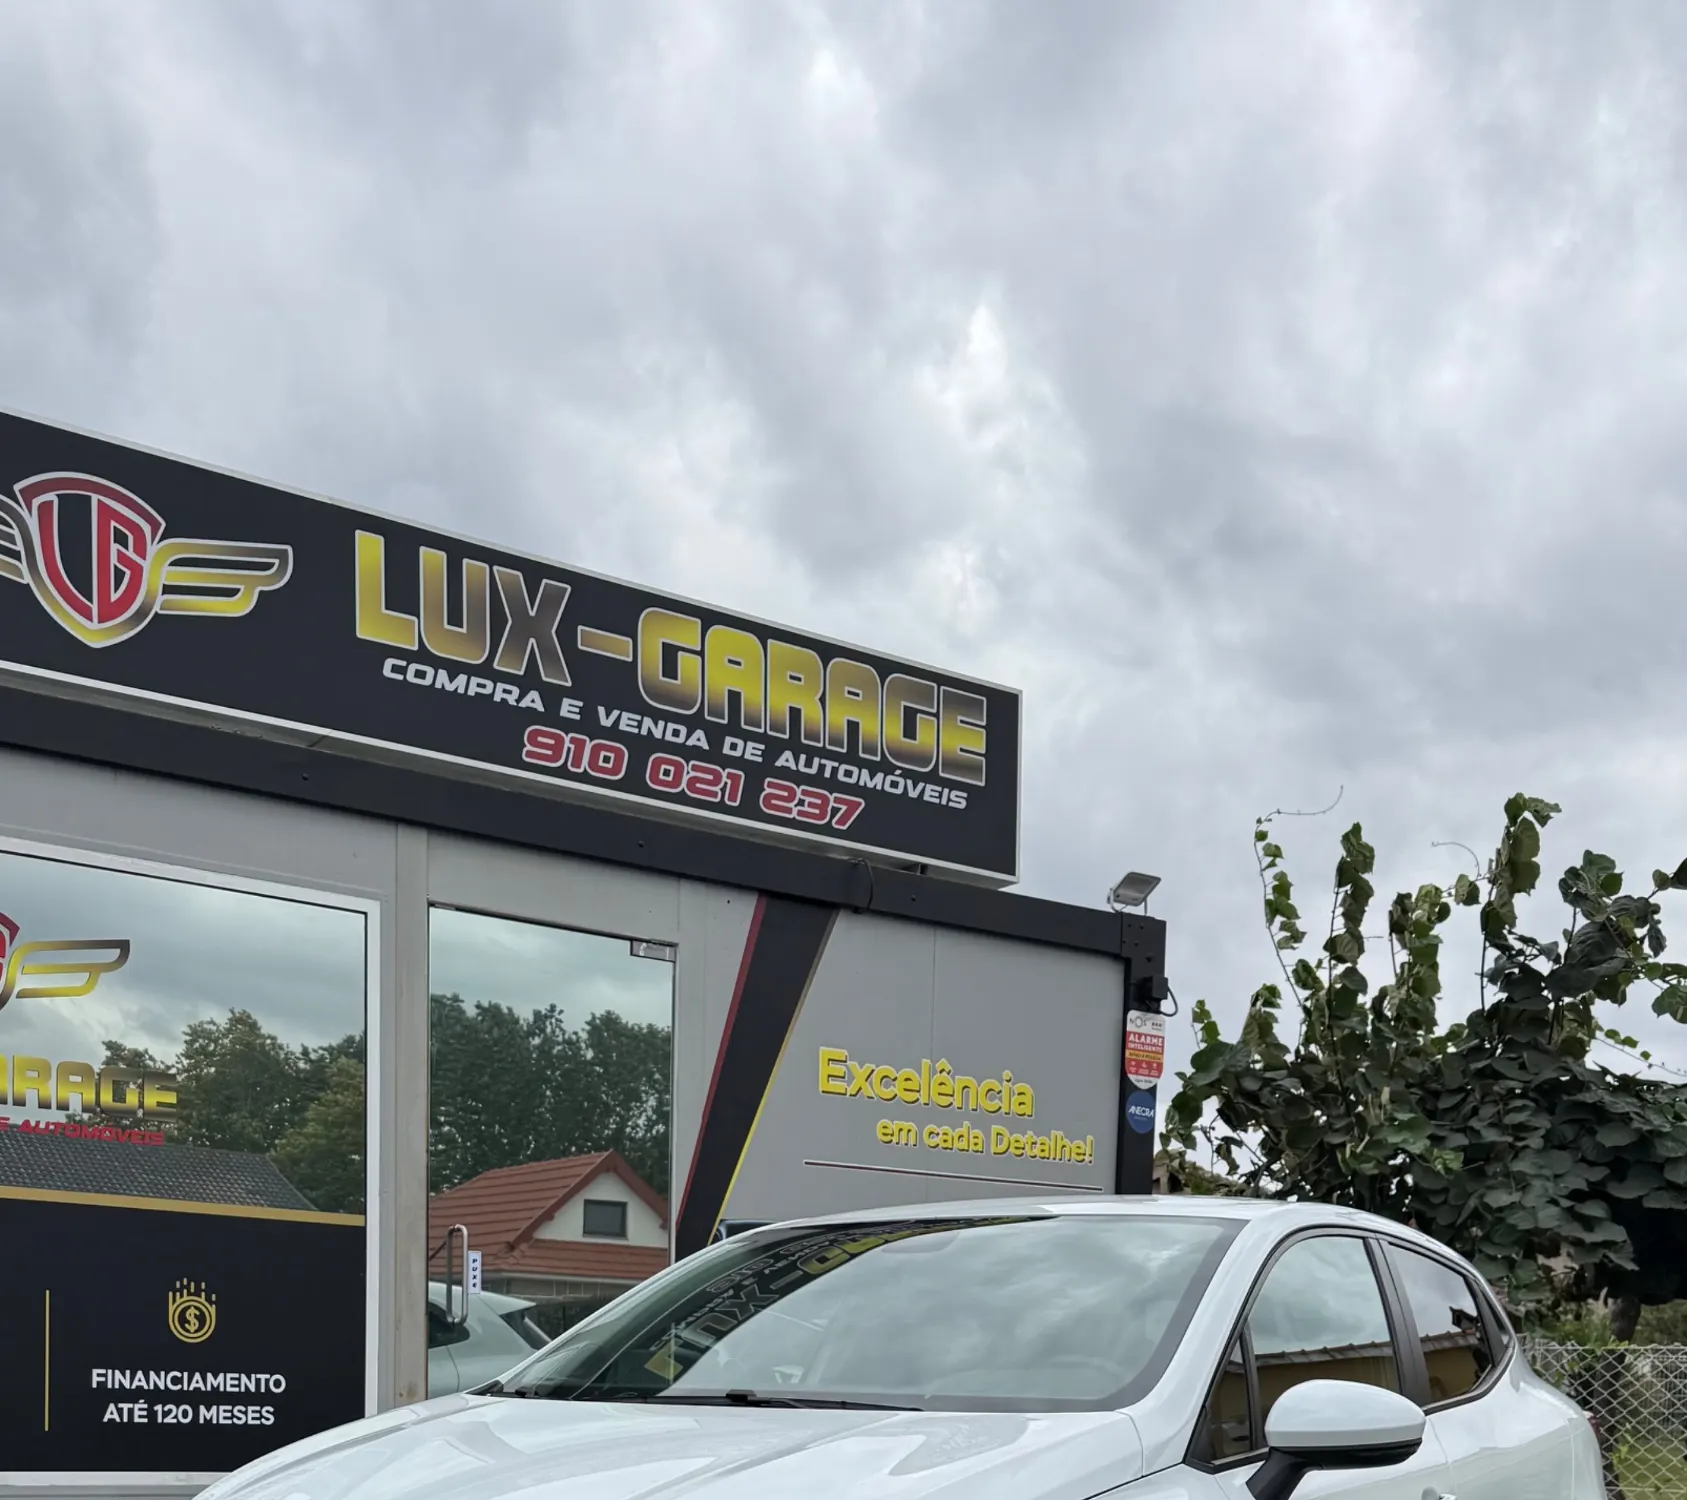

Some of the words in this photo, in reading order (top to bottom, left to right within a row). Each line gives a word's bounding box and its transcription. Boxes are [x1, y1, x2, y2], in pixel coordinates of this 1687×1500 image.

[355, 529, 986, 787] LUX-GARAGE
[383, 657, 545, 712] COMPRA
[559, 697, 584, 720] E
[597, 705, 709, 750] VENDA
[723, 735, 765, 763] DE
[775, 750, 969, 810] AUTOMÓVEIS
[522, 725, 628, 780] 910
[646, 752, 745, 806] 021
[760, 777, 865, 830] 237
[1128, 1033, 1163, 1046] ALARME
[818, 1046, 1034, 1118] Excelência
[18, 1118, 165, 1147] AUTOMÓVEIS
[876, 1118, 918, 1147] em
[923, 1121, 984, 1153] cada
[990, 1125, 1094, 1164] Detalhe!
[91, 1368, 287, 1394] FINANCIAMENTO
[102, 1399, 149, 1424] ATÉ
[153, 1403, 193, 1424] 120
[198, 1404, 275, 1426] MESES
